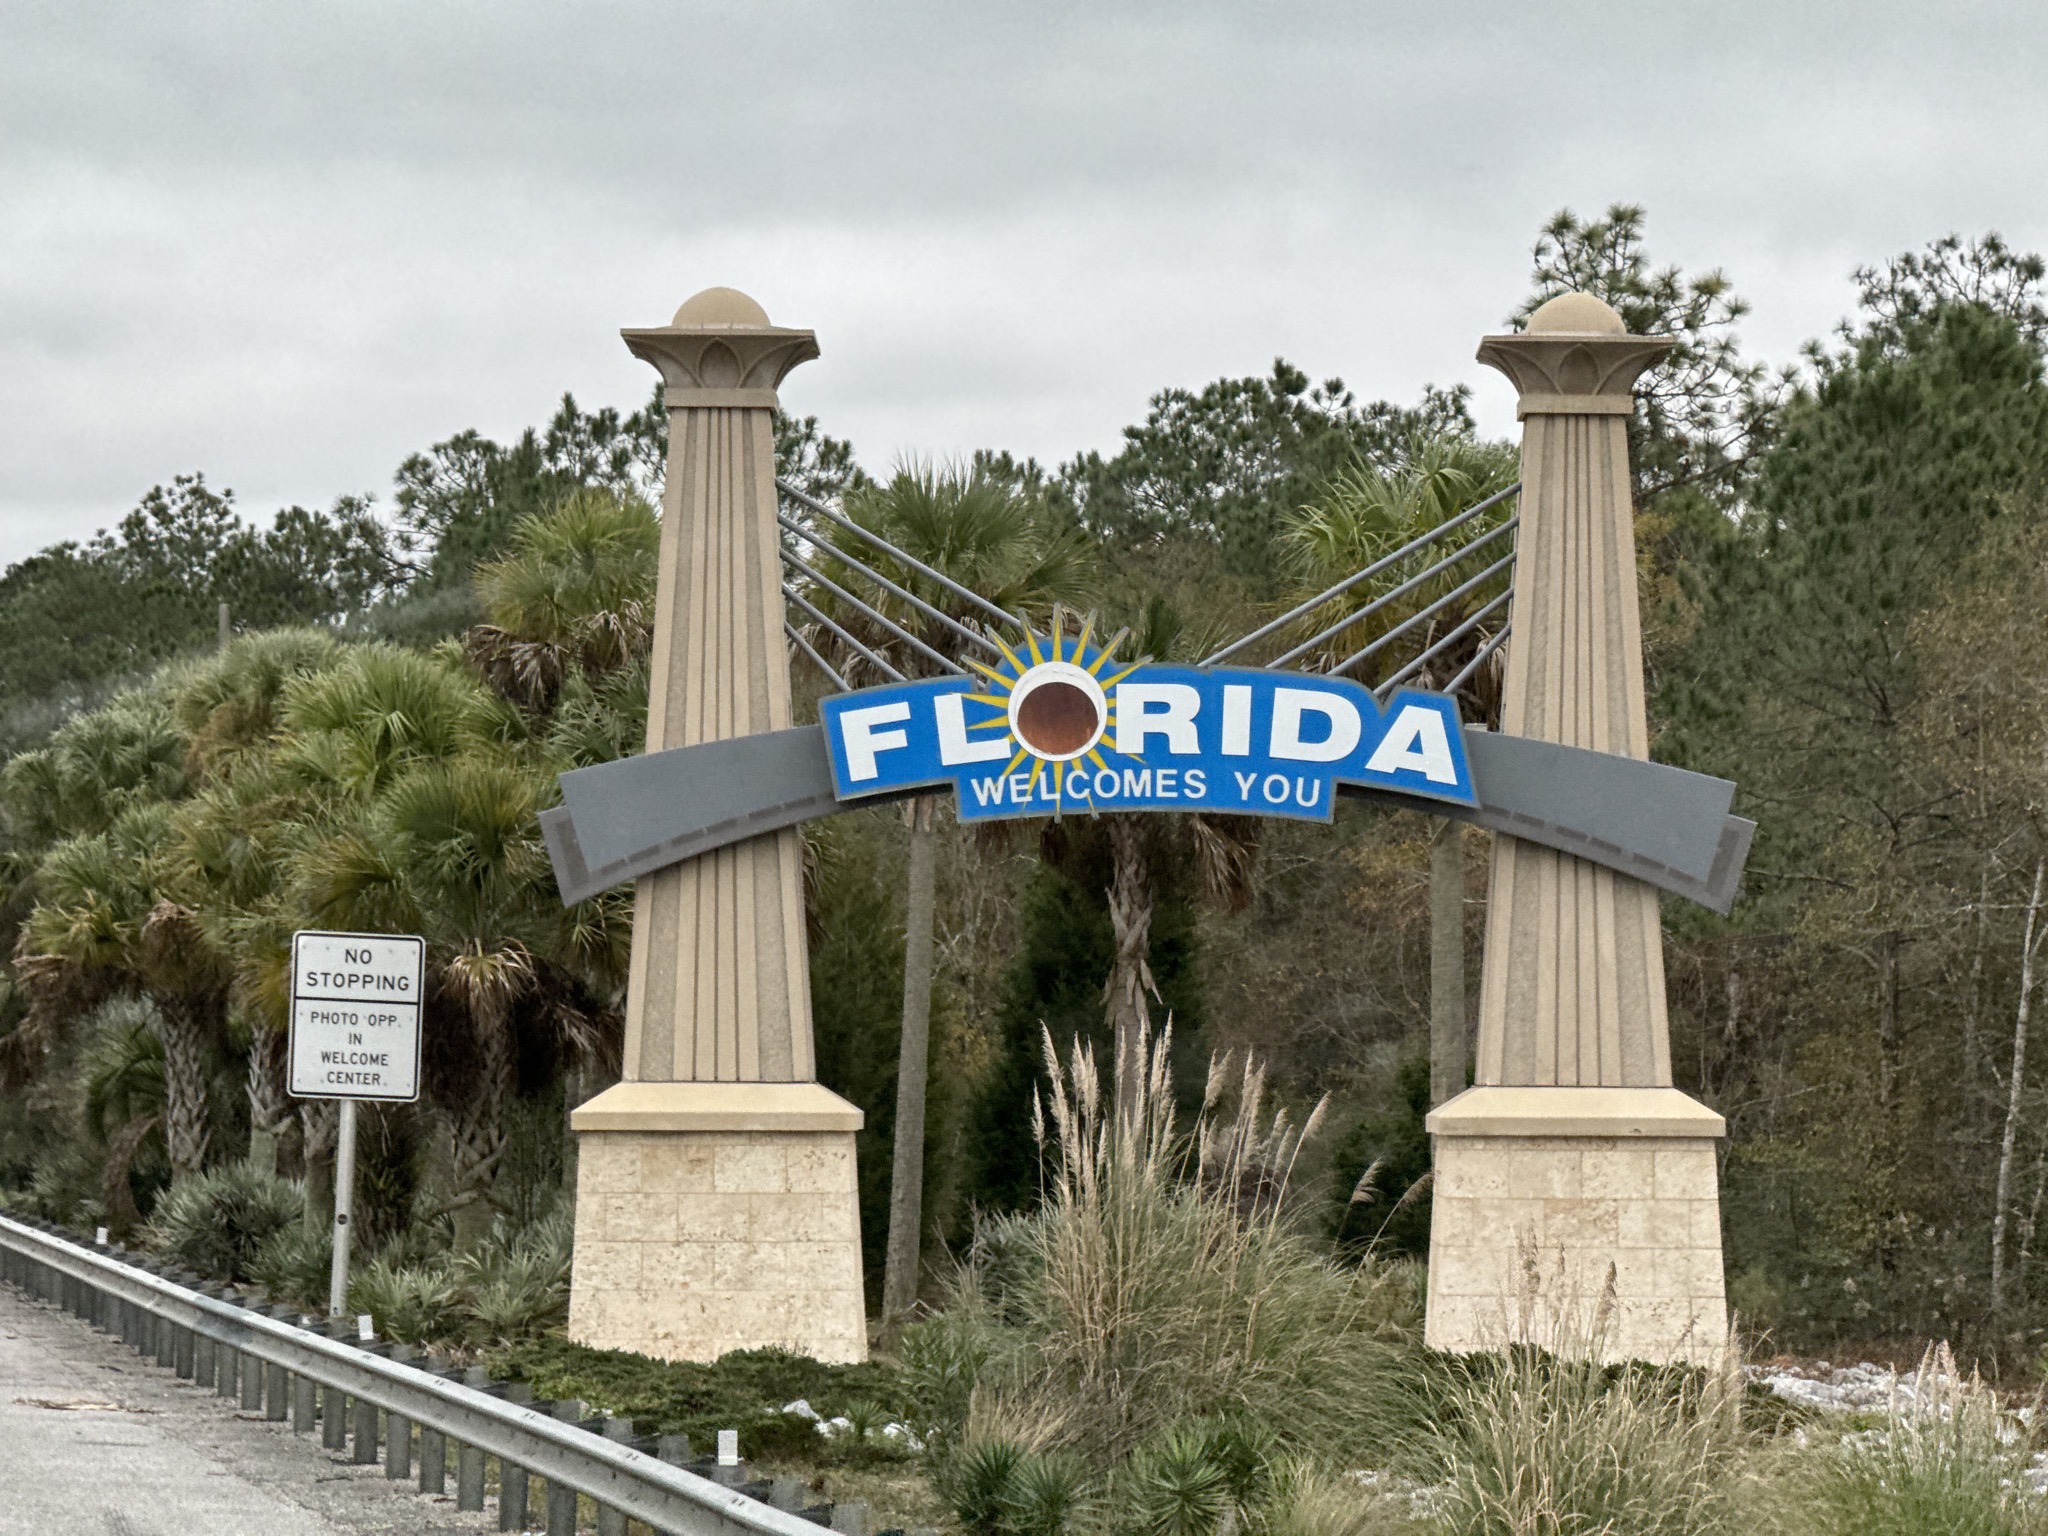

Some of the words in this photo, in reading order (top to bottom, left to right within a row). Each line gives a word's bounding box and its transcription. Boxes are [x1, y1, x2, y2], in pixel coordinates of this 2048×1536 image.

[839, 660, 1458, 786] FLORIDA
[970, 768, 1206, 807] WELCOMES
[1236, 771, 1321, 808] YOU
[344, 948, 373, 965] NO
[306, 971, 410, 992] STOPPING
[310, 1011, 359, 1026] PHOTO
[348, 1032, 363, 1046] IN
[321, 1050, 389, 1067] WELCOME
[326, 1071, 381, 1086] CENTER
